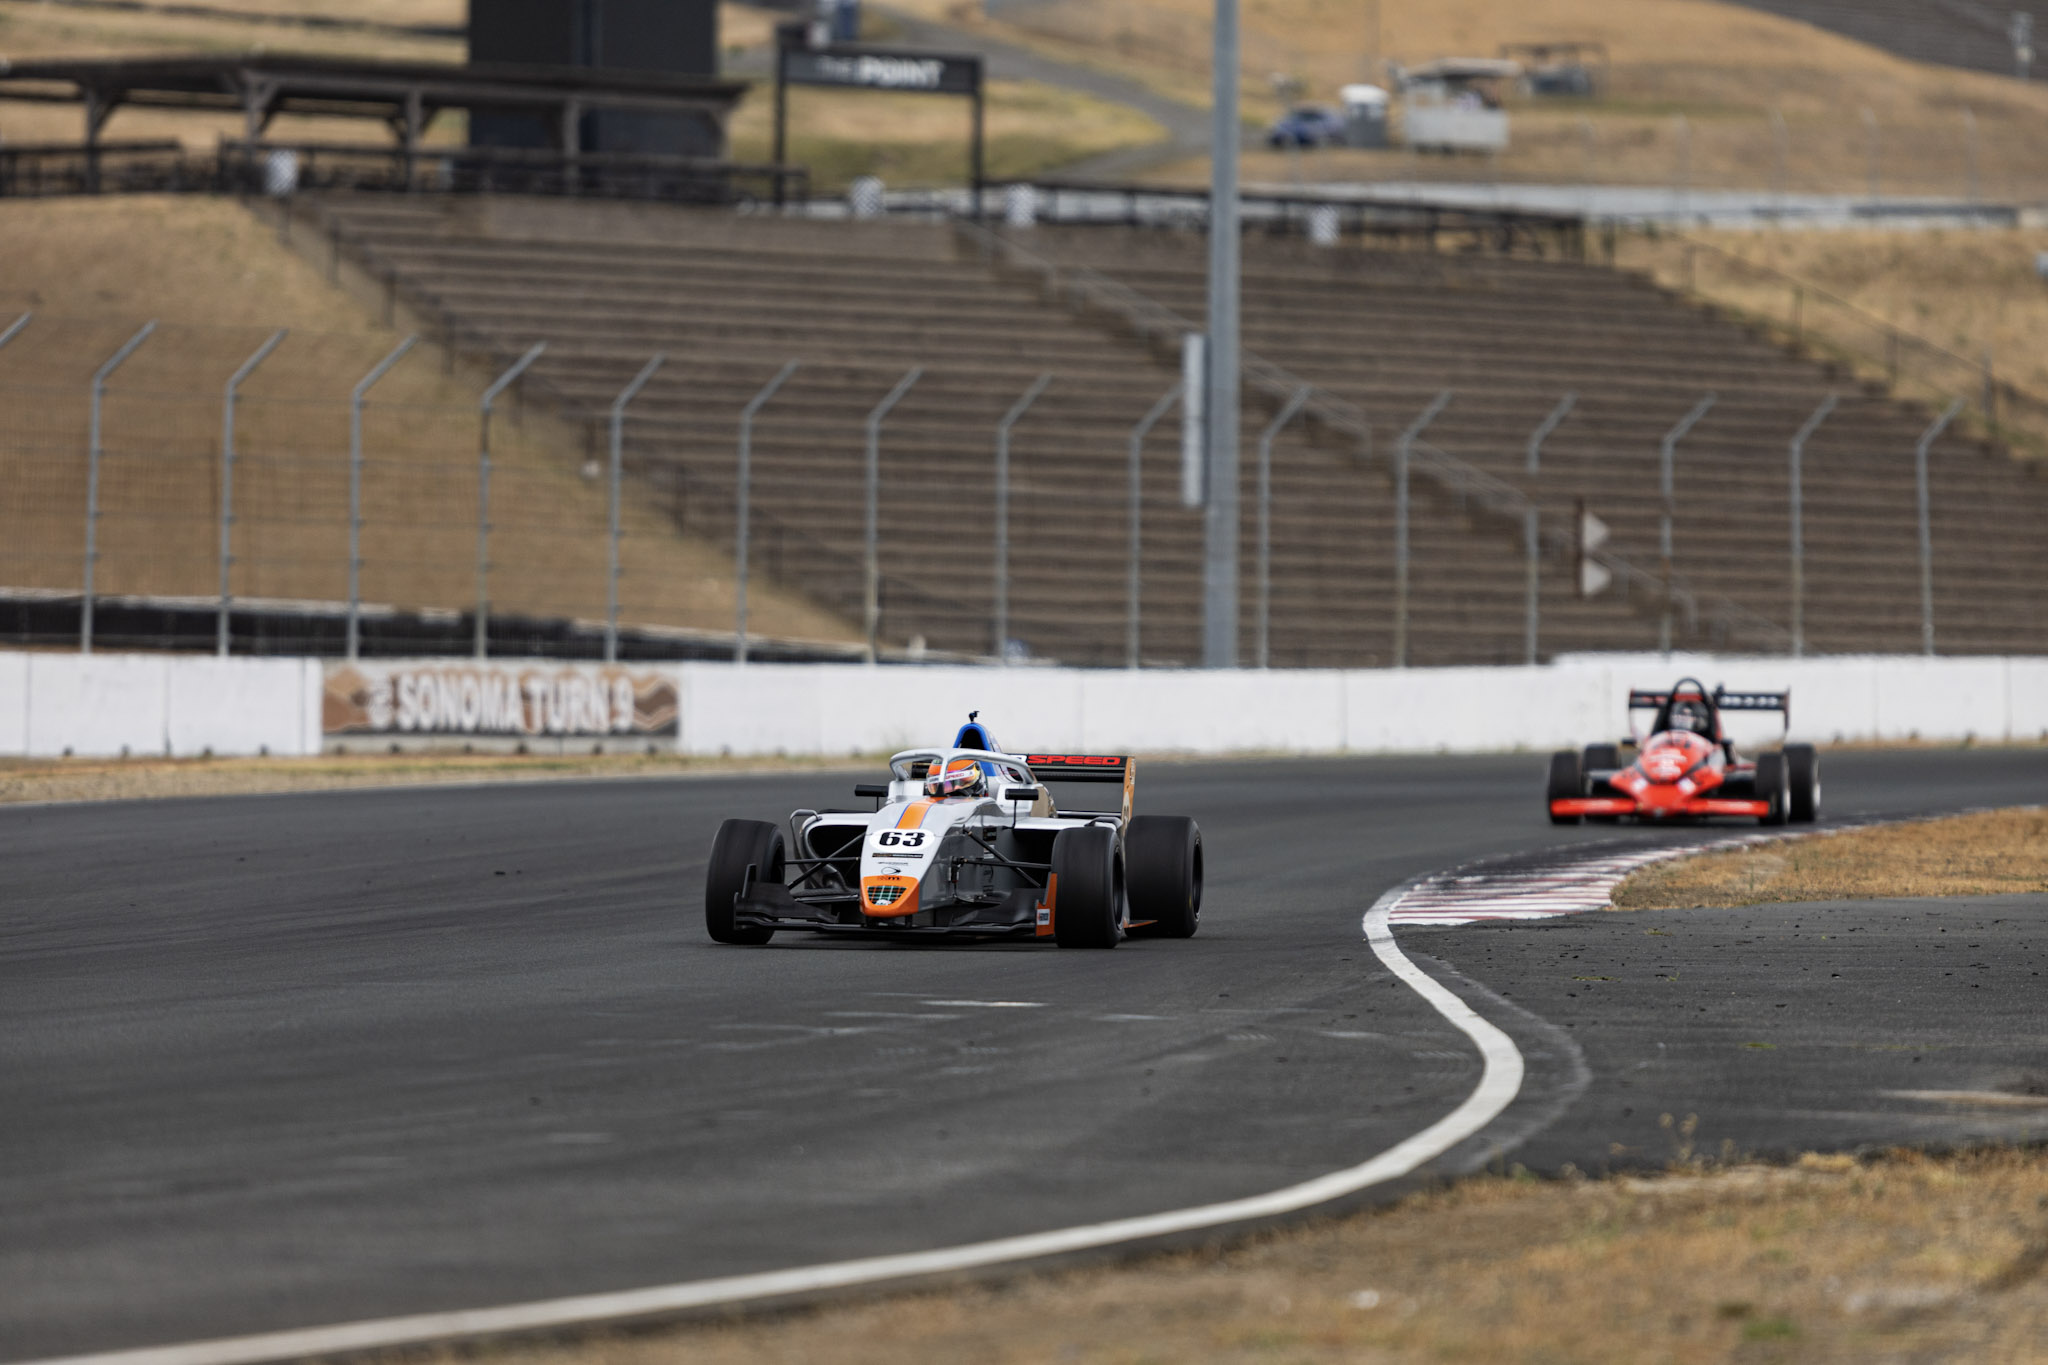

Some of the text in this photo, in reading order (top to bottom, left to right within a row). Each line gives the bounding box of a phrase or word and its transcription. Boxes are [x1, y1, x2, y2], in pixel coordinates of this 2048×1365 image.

[397, 671, 524, 732] SONOMA
[525, 674, 610, 733] TURN
[611, 675, 634, 732] 9
[1026, 755, 1121, 765] SPEED
[879, 831, 926, 847] 63
